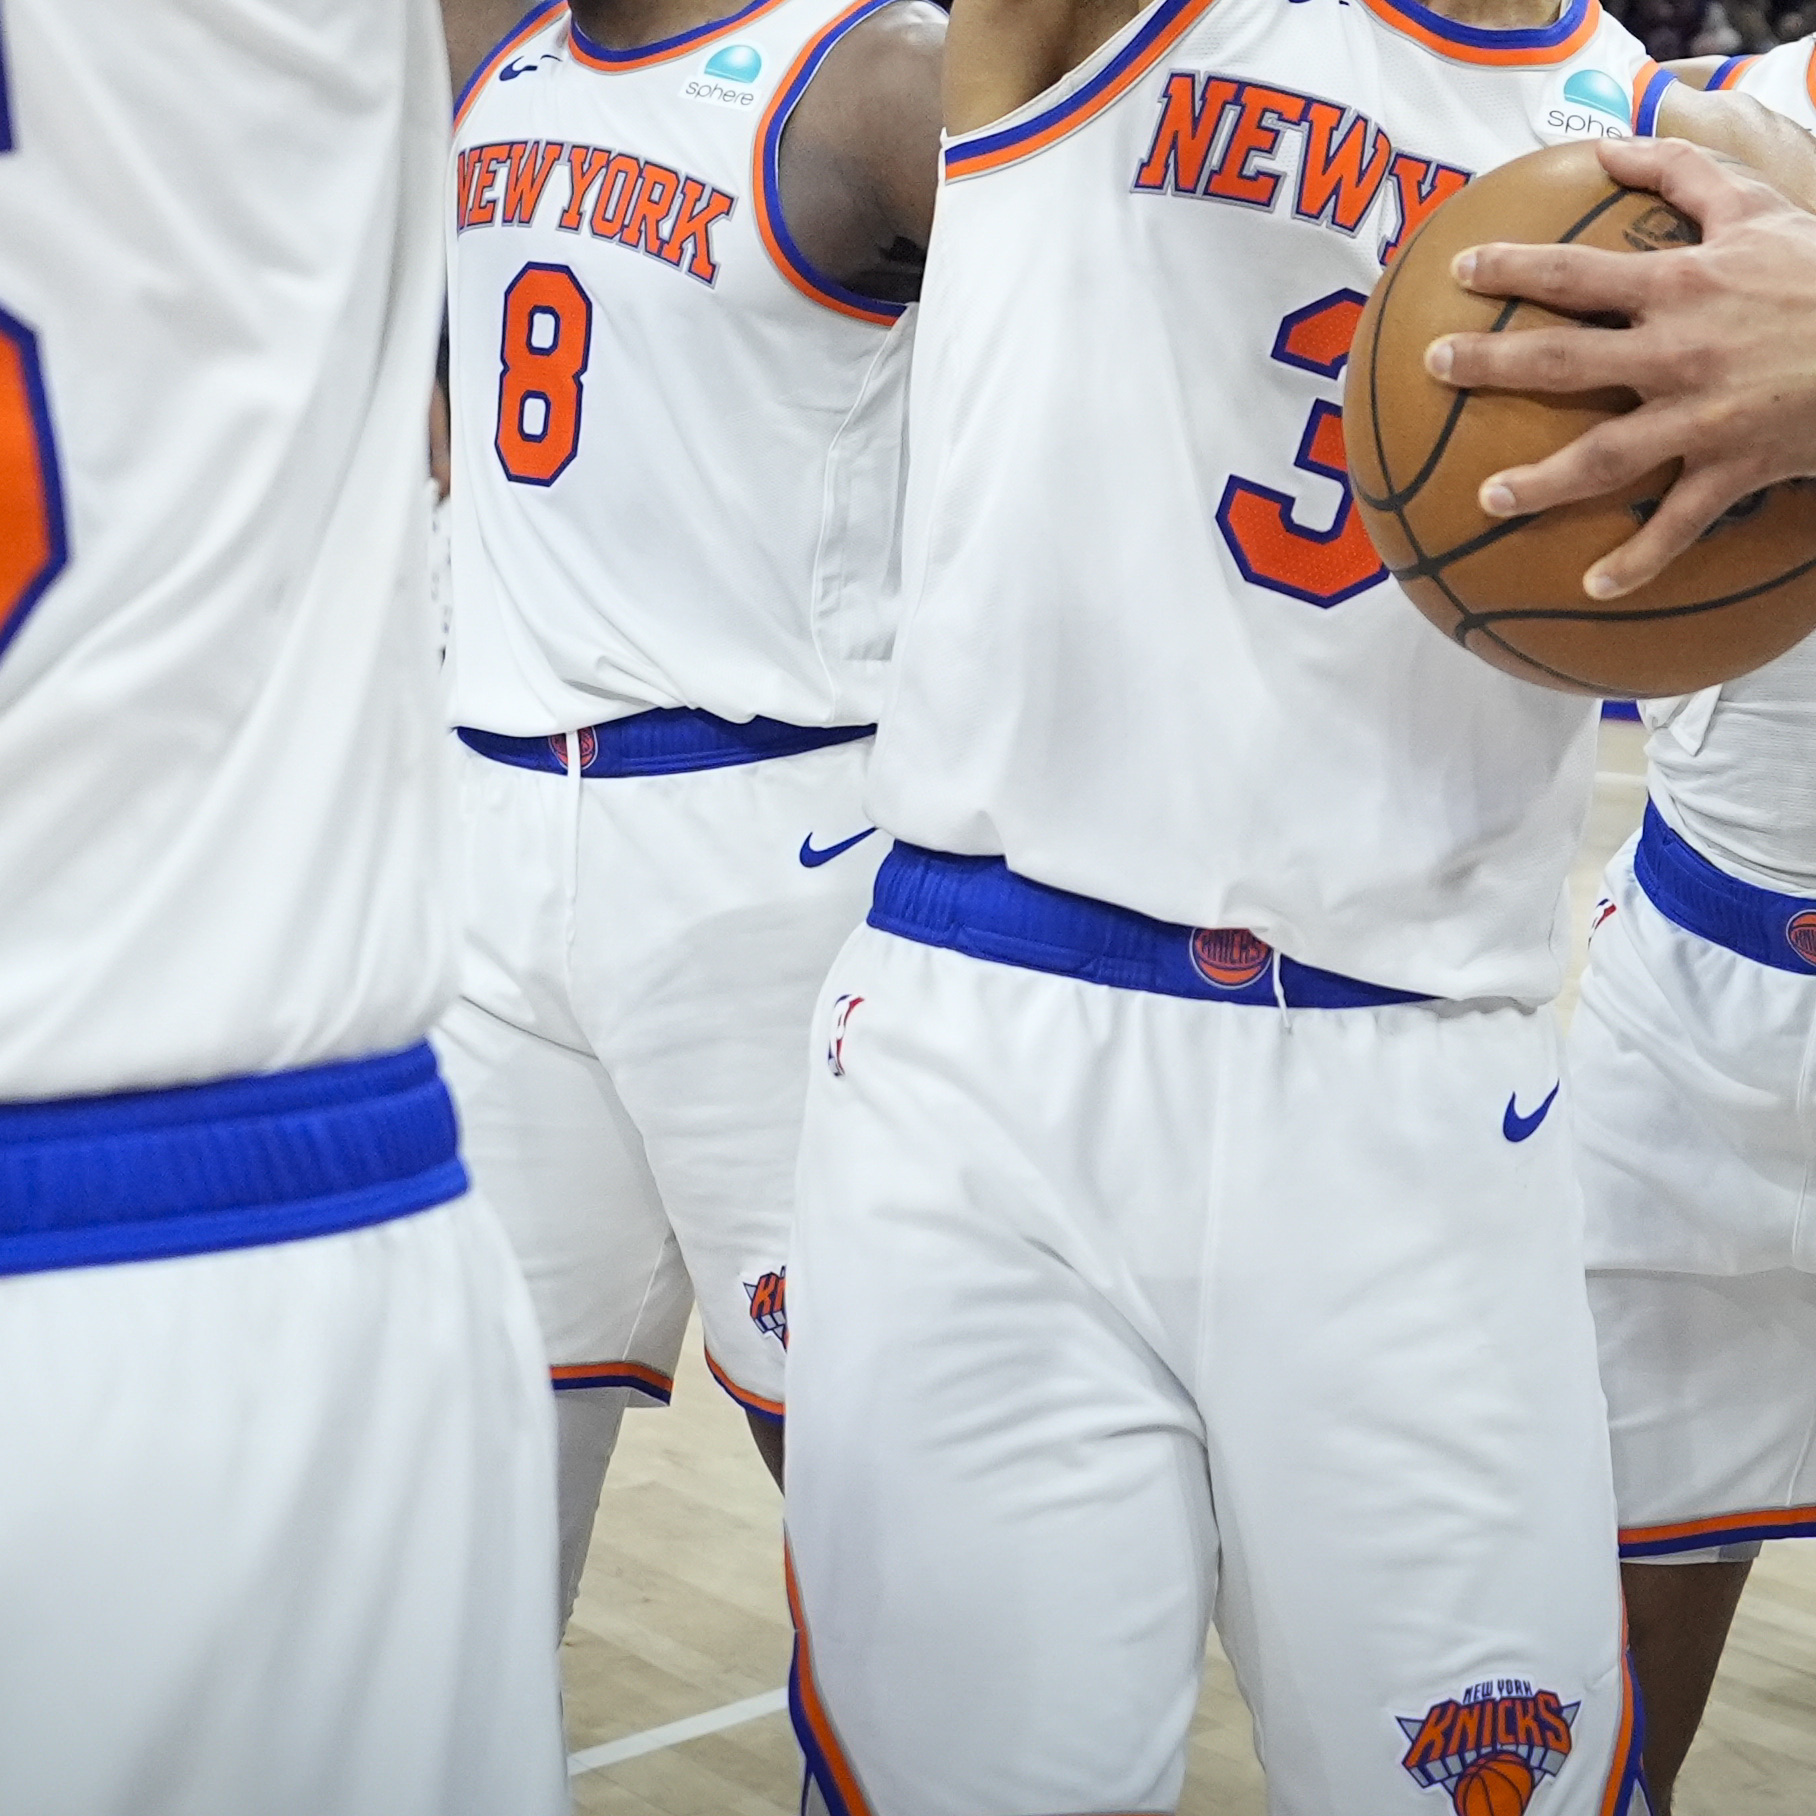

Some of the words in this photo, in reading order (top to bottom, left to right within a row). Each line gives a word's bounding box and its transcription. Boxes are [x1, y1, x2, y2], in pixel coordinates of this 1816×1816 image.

[685, 81, 755, 106] sphere
[1130, 67, 1391, 239] NEW
[556, 142, 739, 289] YORK
[495, 261, 593, 487] 8
[1215, 287, 1390, 609] 3
[1402, 1689, 1572, 1772] KNICKS
[1463, 1681, 1494, 1704] NEW
[1497, 1679, 1533, 1697] YORK
